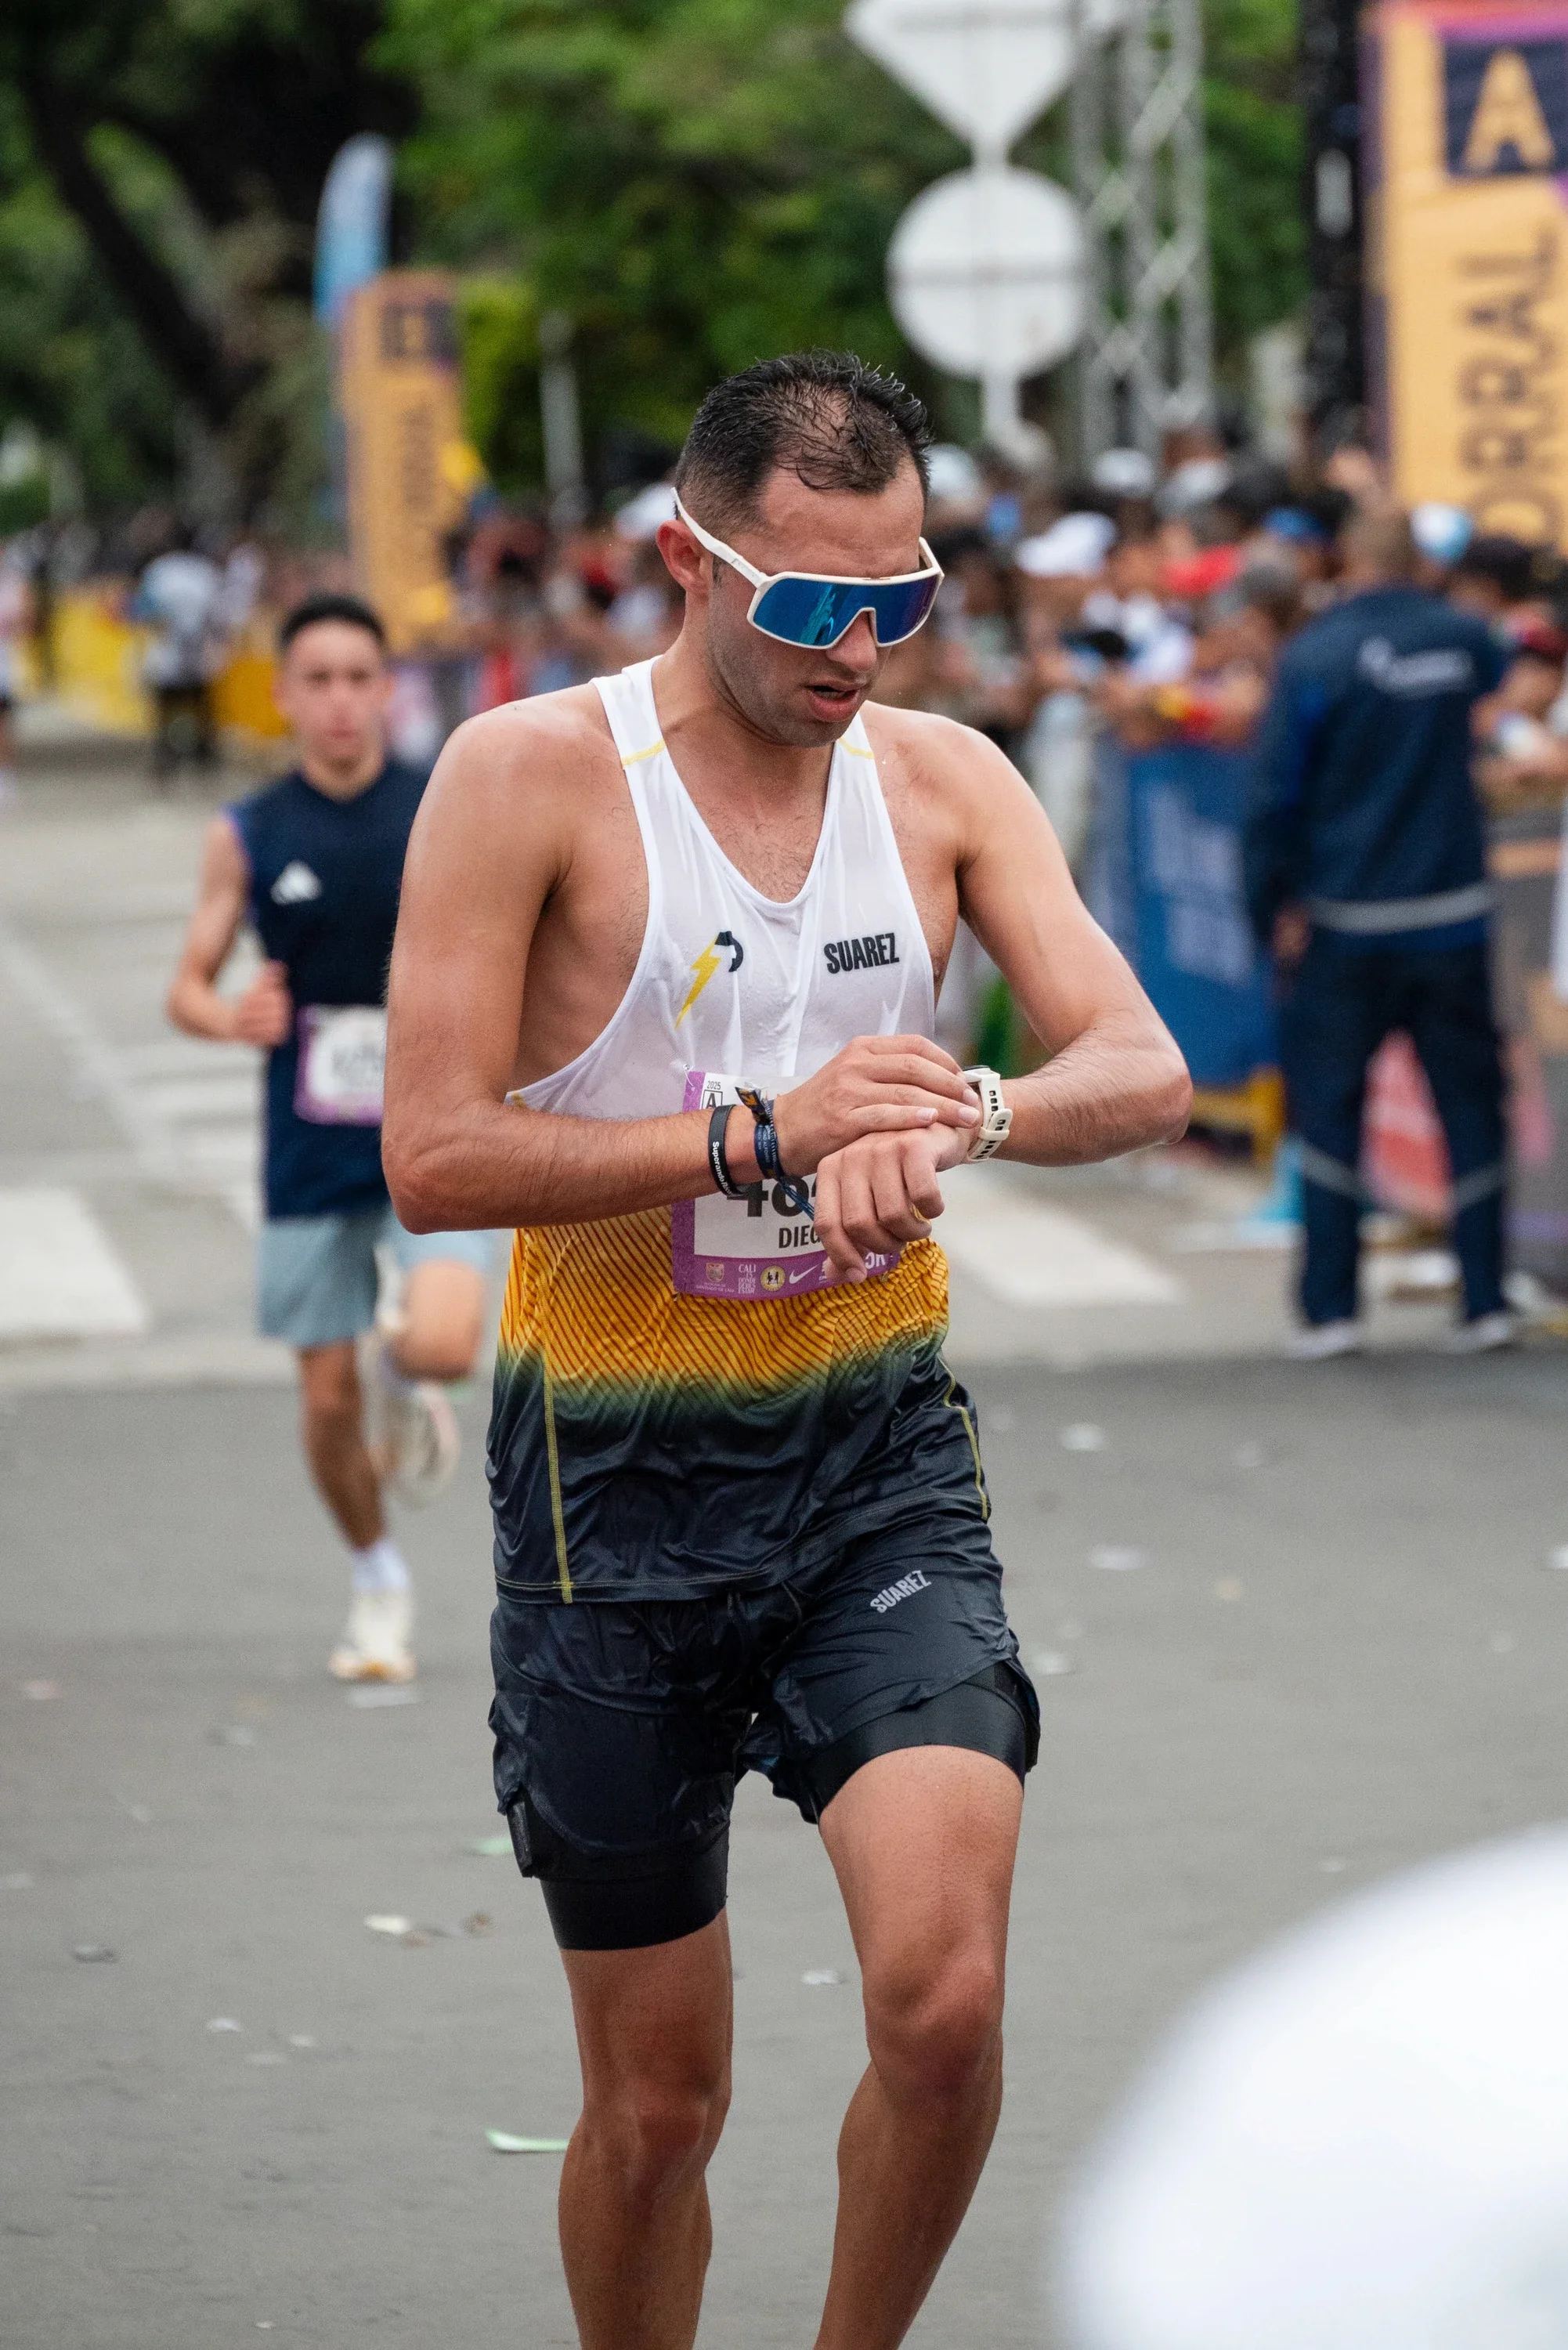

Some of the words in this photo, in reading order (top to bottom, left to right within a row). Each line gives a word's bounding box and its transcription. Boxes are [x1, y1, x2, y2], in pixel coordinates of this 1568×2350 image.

[1461, 44, 1558, 174] A
[1454, 221, 1560, 544] ORRAL
[824, 932, 900, 974] SUAREZ
[706, 1080, 721, 1090] 2025
[727, 1175, 816, 1217] 40
[779, 1225, 820, 1249] DIEG
[870, 1570, 932, 1613] SUAREZ
